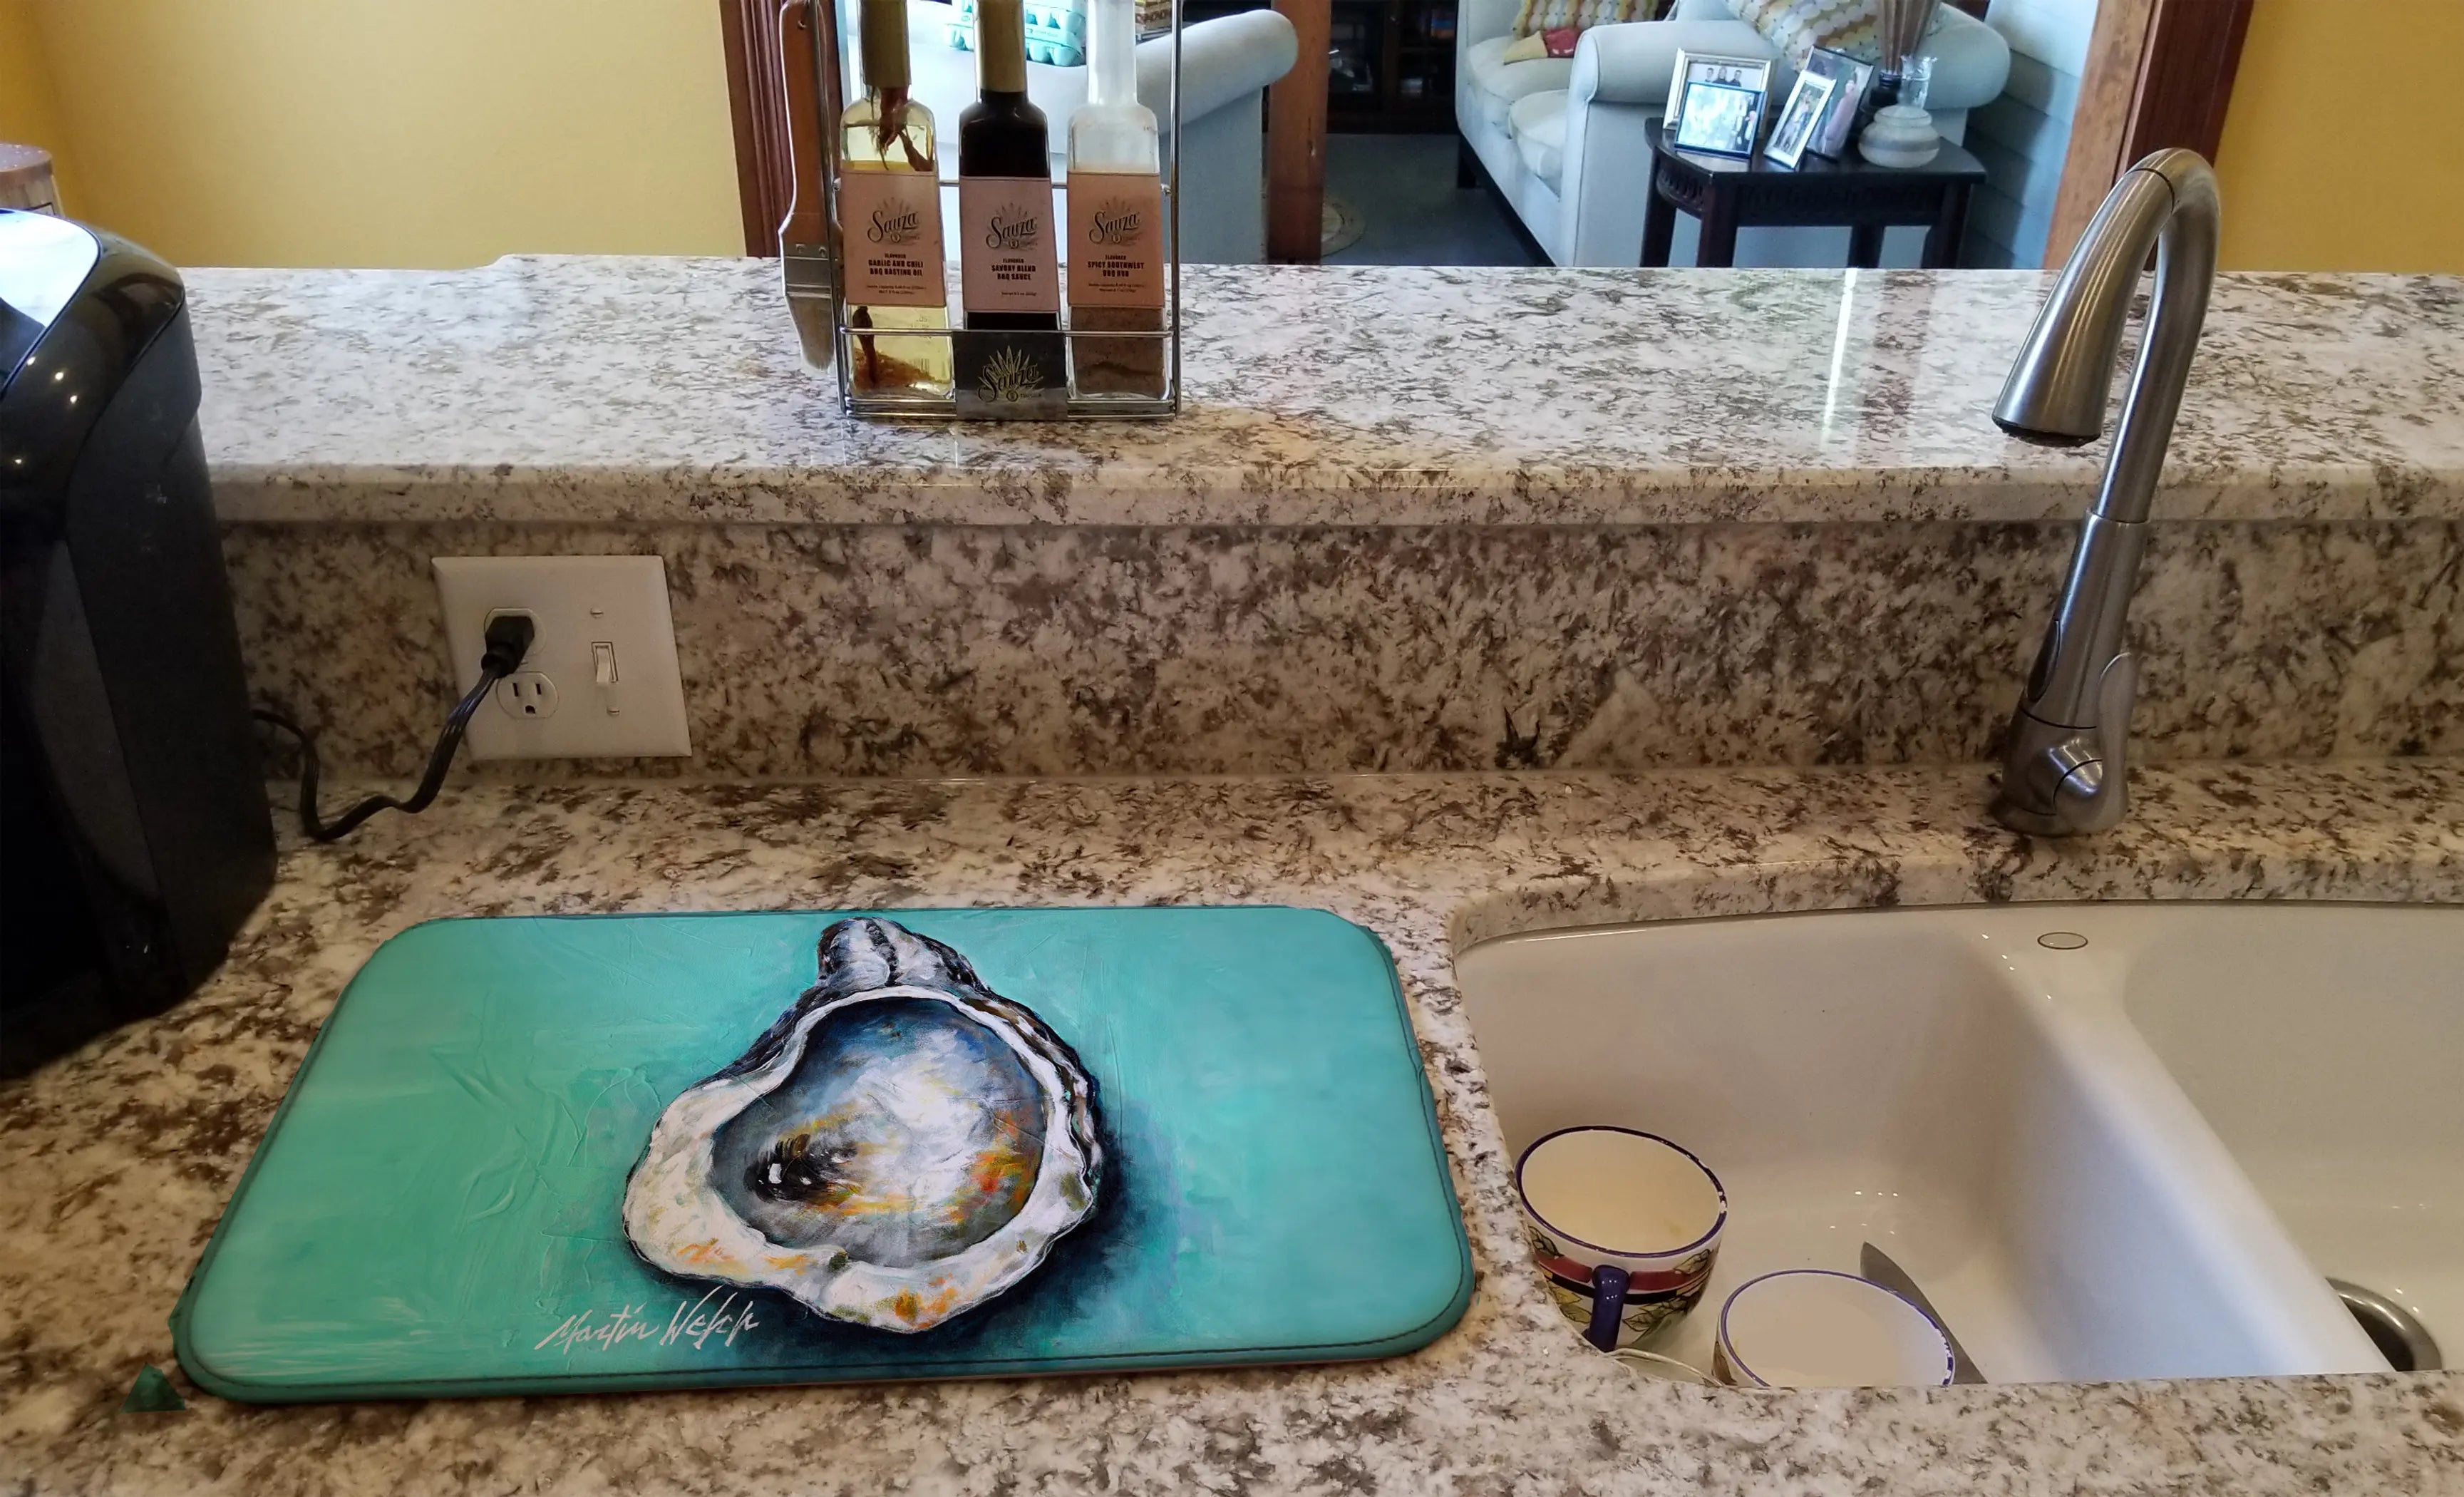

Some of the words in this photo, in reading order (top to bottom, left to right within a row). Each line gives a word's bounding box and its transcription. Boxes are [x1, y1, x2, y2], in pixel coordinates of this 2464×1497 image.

[867, 210, 918, 243] Sauza
[986, 216, 1037, 249] Sauza
[1089, 211, 1140, 245] Sauza
[534, 1302, 660, 1355] Martin
[659, 1284, 760, 1350] Welch
